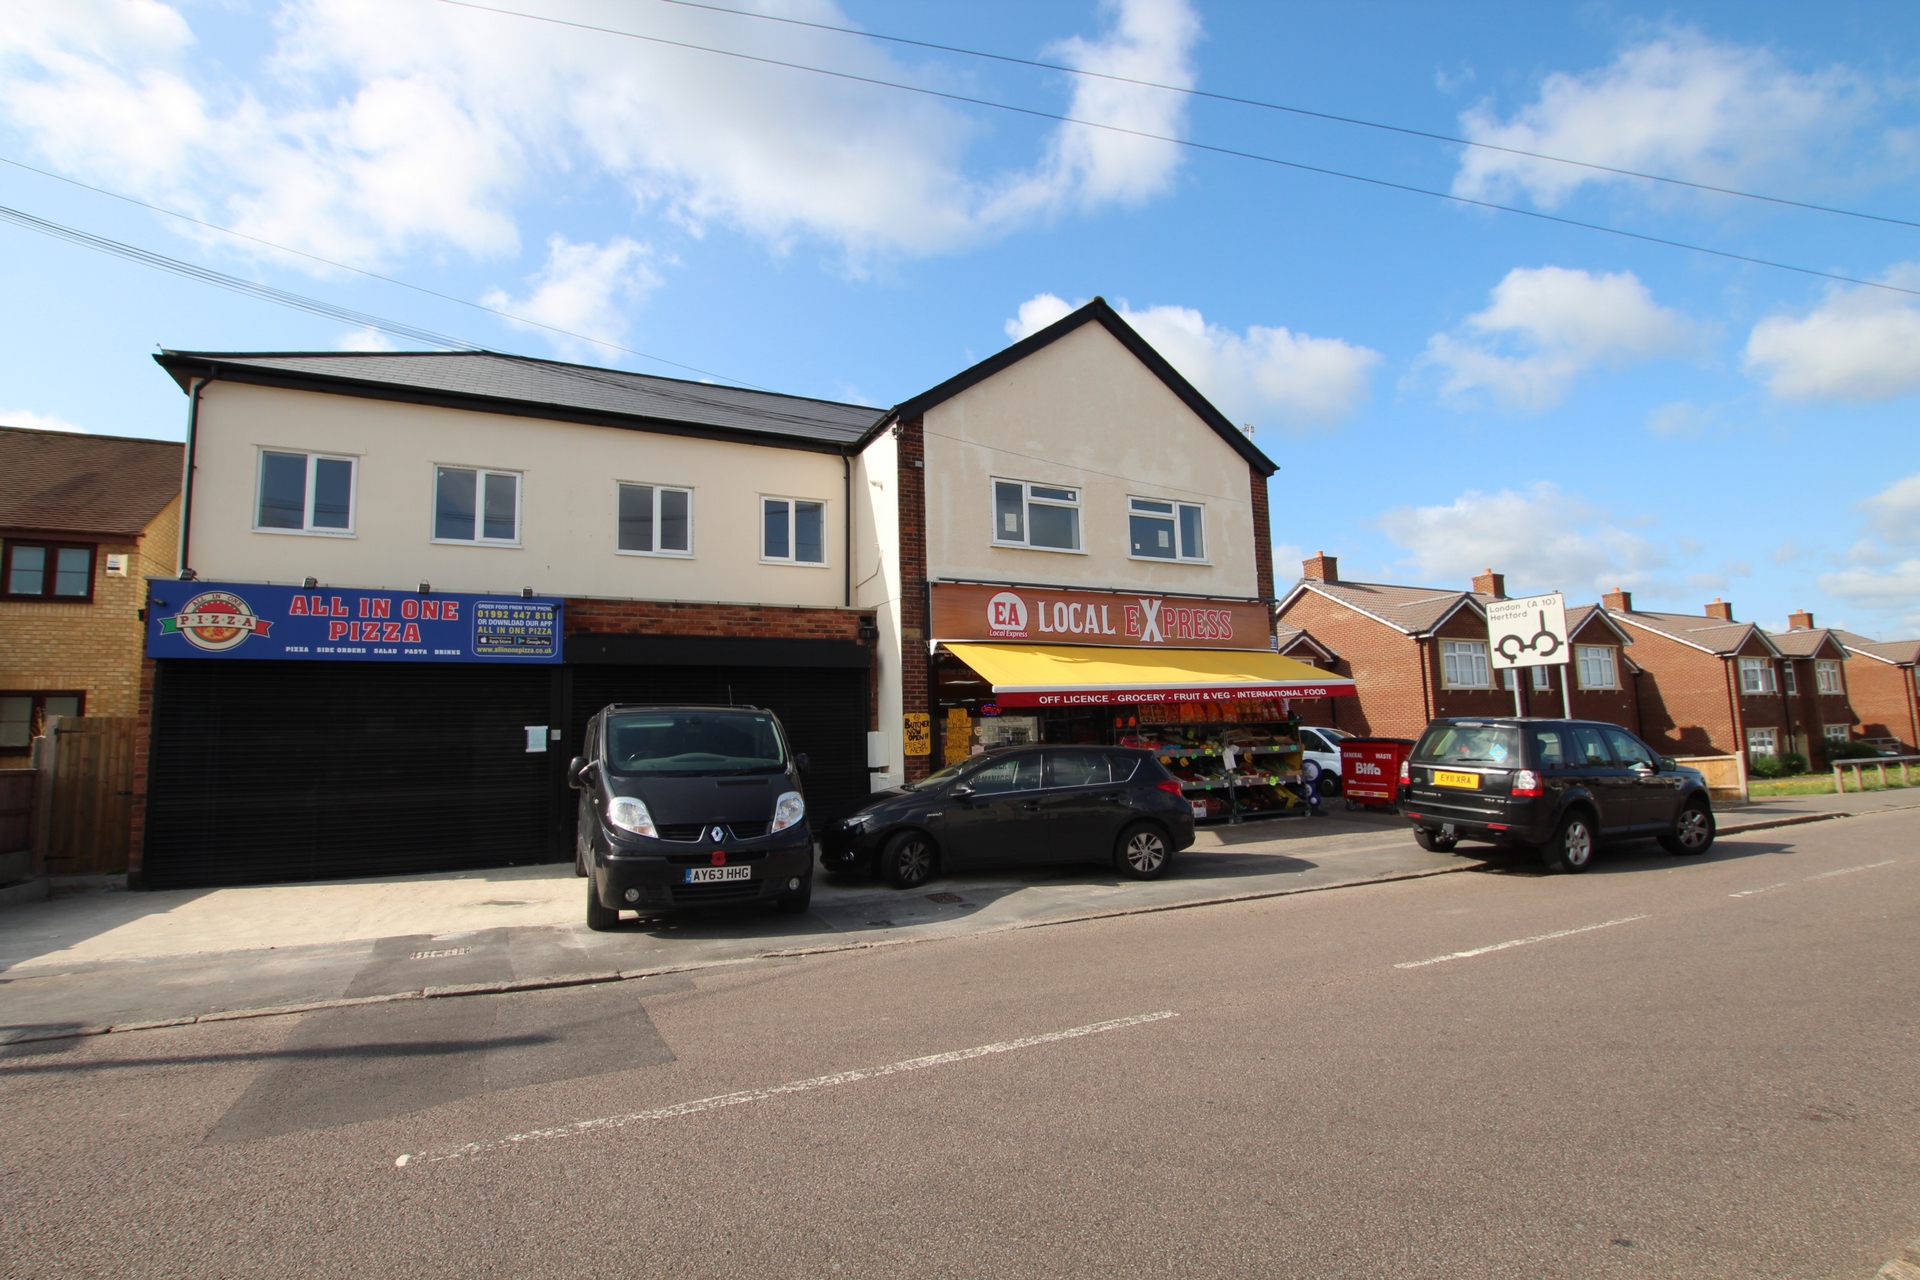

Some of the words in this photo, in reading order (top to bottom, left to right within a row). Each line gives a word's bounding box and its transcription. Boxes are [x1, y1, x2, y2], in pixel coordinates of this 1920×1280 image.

[192, 596, 206, 606] ALL
[227, 596, 243, 608] ONE
[289, 595, 348, 616] ALL
[359, 598, 391, 618] IN
[401, 599, 459, 620] ONE
[477, 610, 508, 618] 01992
[994, 602, 1021, 626] EA
[1489, 604, 1520, 613] London
[1037, 600, 1116, 635] LOCAL
[1124, 598, 1233, 642] EXPRESS
[1490, 611, 1528, 621] Hertford
[328, 620, 421, 642] PIZZA
[1006, 630, 1028, 638] Express
[1039, 696, 1061, 704] OFF
[1064, 695, 1109, 703] LICENCE
[1117, 693, 1166, 702] GROCERY
[1237, 690, 1303, 698] INTERNATIONAL
[905, 718, 930, 729] BUTCHER
[905, 741, 926, 749] FRESH
[1355, 762, 1381, 775] Biffa
[1456, 776, 1471, 784] XRA
[693, 868, 724, 881] AY63
[726, 867, 749, 879] HHG
